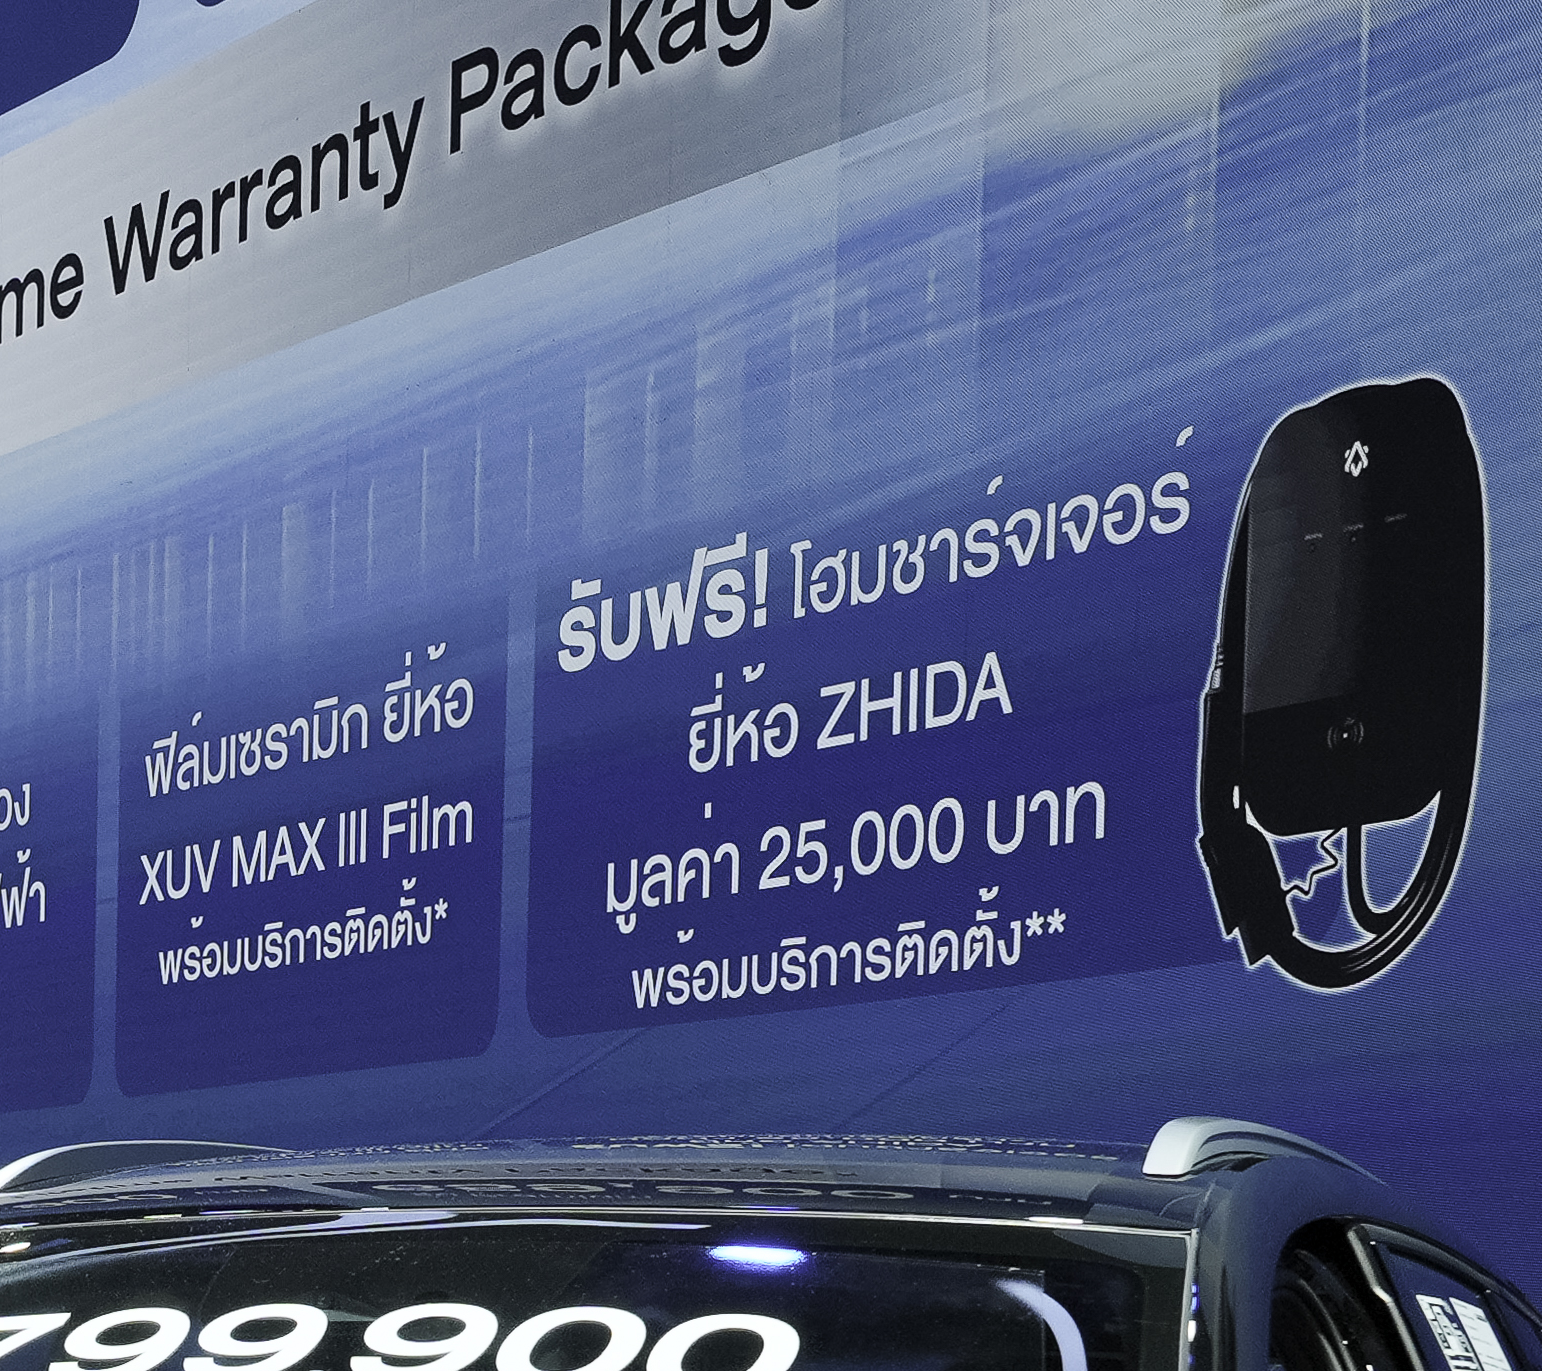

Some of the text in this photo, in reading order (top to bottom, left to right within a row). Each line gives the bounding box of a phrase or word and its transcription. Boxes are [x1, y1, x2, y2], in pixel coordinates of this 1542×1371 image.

[104, 96, 425, 296] Warranty
[449, 0, 825, 154] Packag
[557, 424, 1194, 673] รับฟรี! โฮมชาร์จเจอร์
[145, 642, 475, 798] ฟิล์มเซรามิก ยี่ห้อ
[688, 651, 1013, 773] ยี่ห้อ ZHIDA
[139, 796, 474, 905] XUV MAX III Film
[606, 780, 1107, 935] มูลค่า 25,000 บาท
